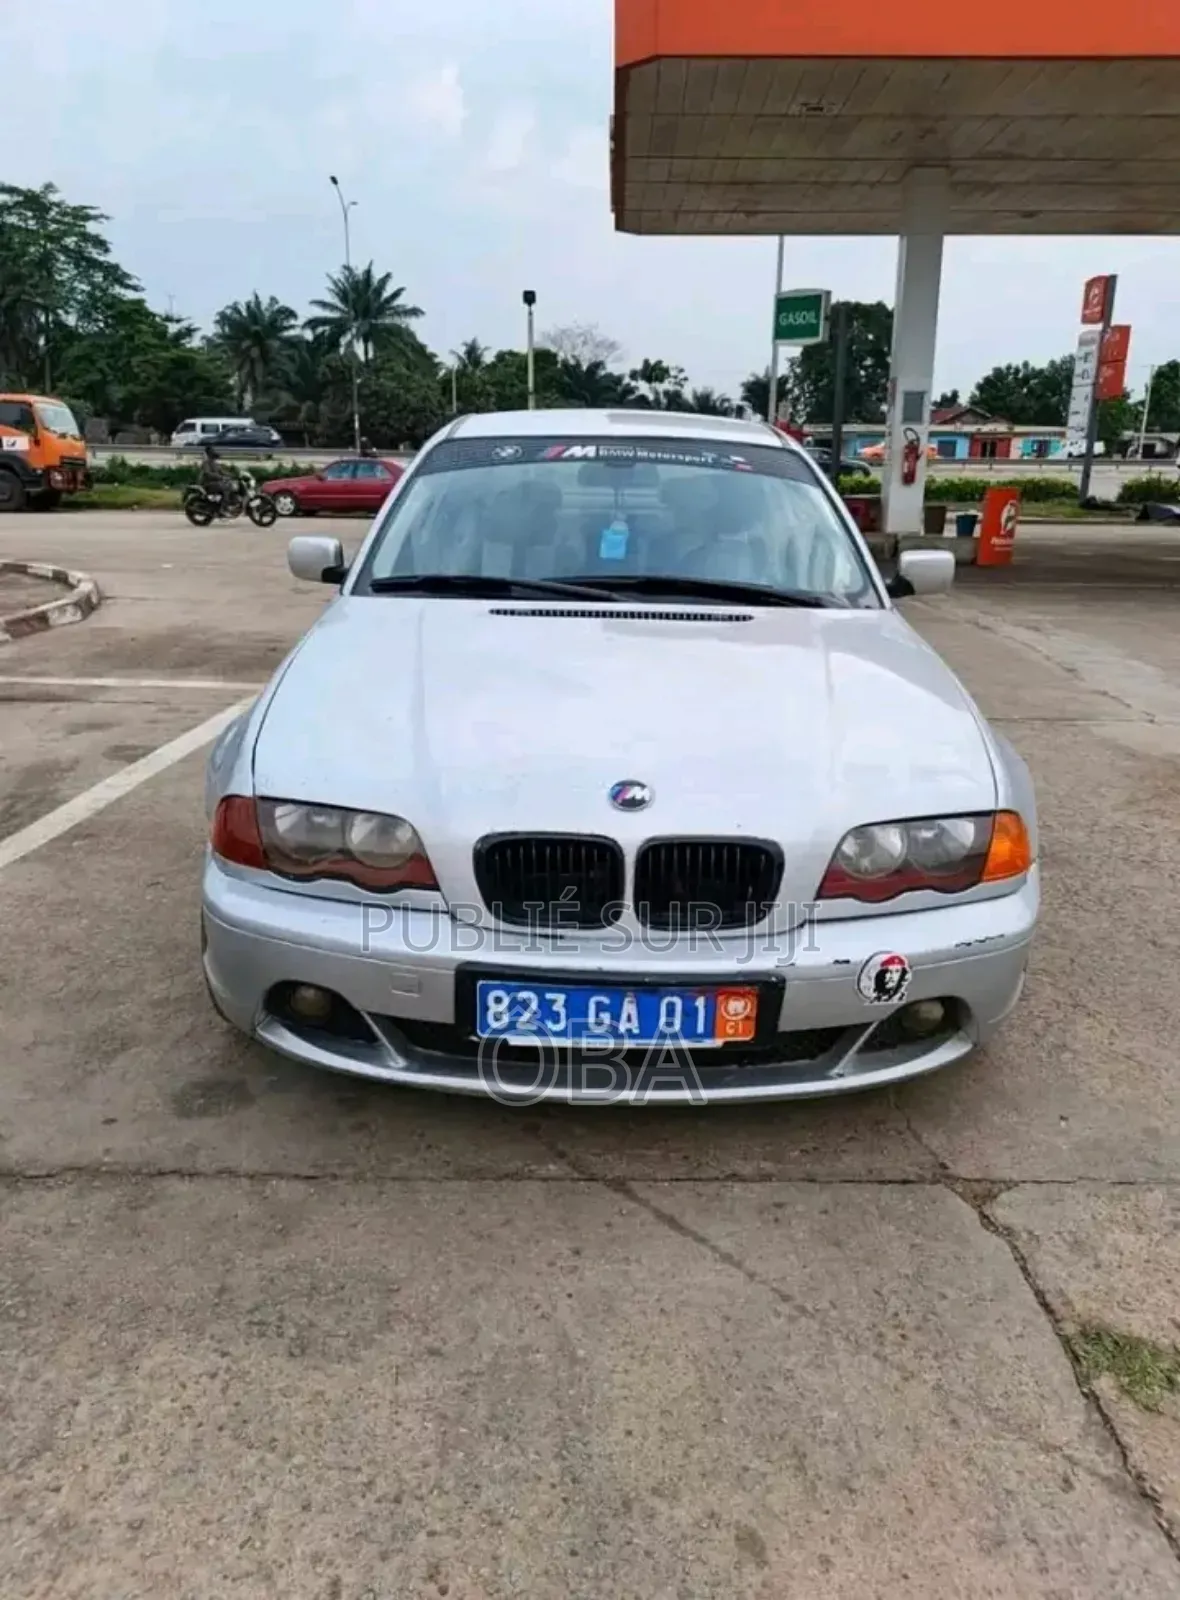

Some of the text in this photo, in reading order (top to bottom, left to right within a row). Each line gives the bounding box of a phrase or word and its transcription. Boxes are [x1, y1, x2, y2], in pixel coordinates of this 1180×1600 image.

[779, 310, 818, 327] GASOIL
[599, 446, 634, 457] BMW
[636, 449, 716, 464] Motorsport
[486, 989, 706, 1034] 823 GA 01
